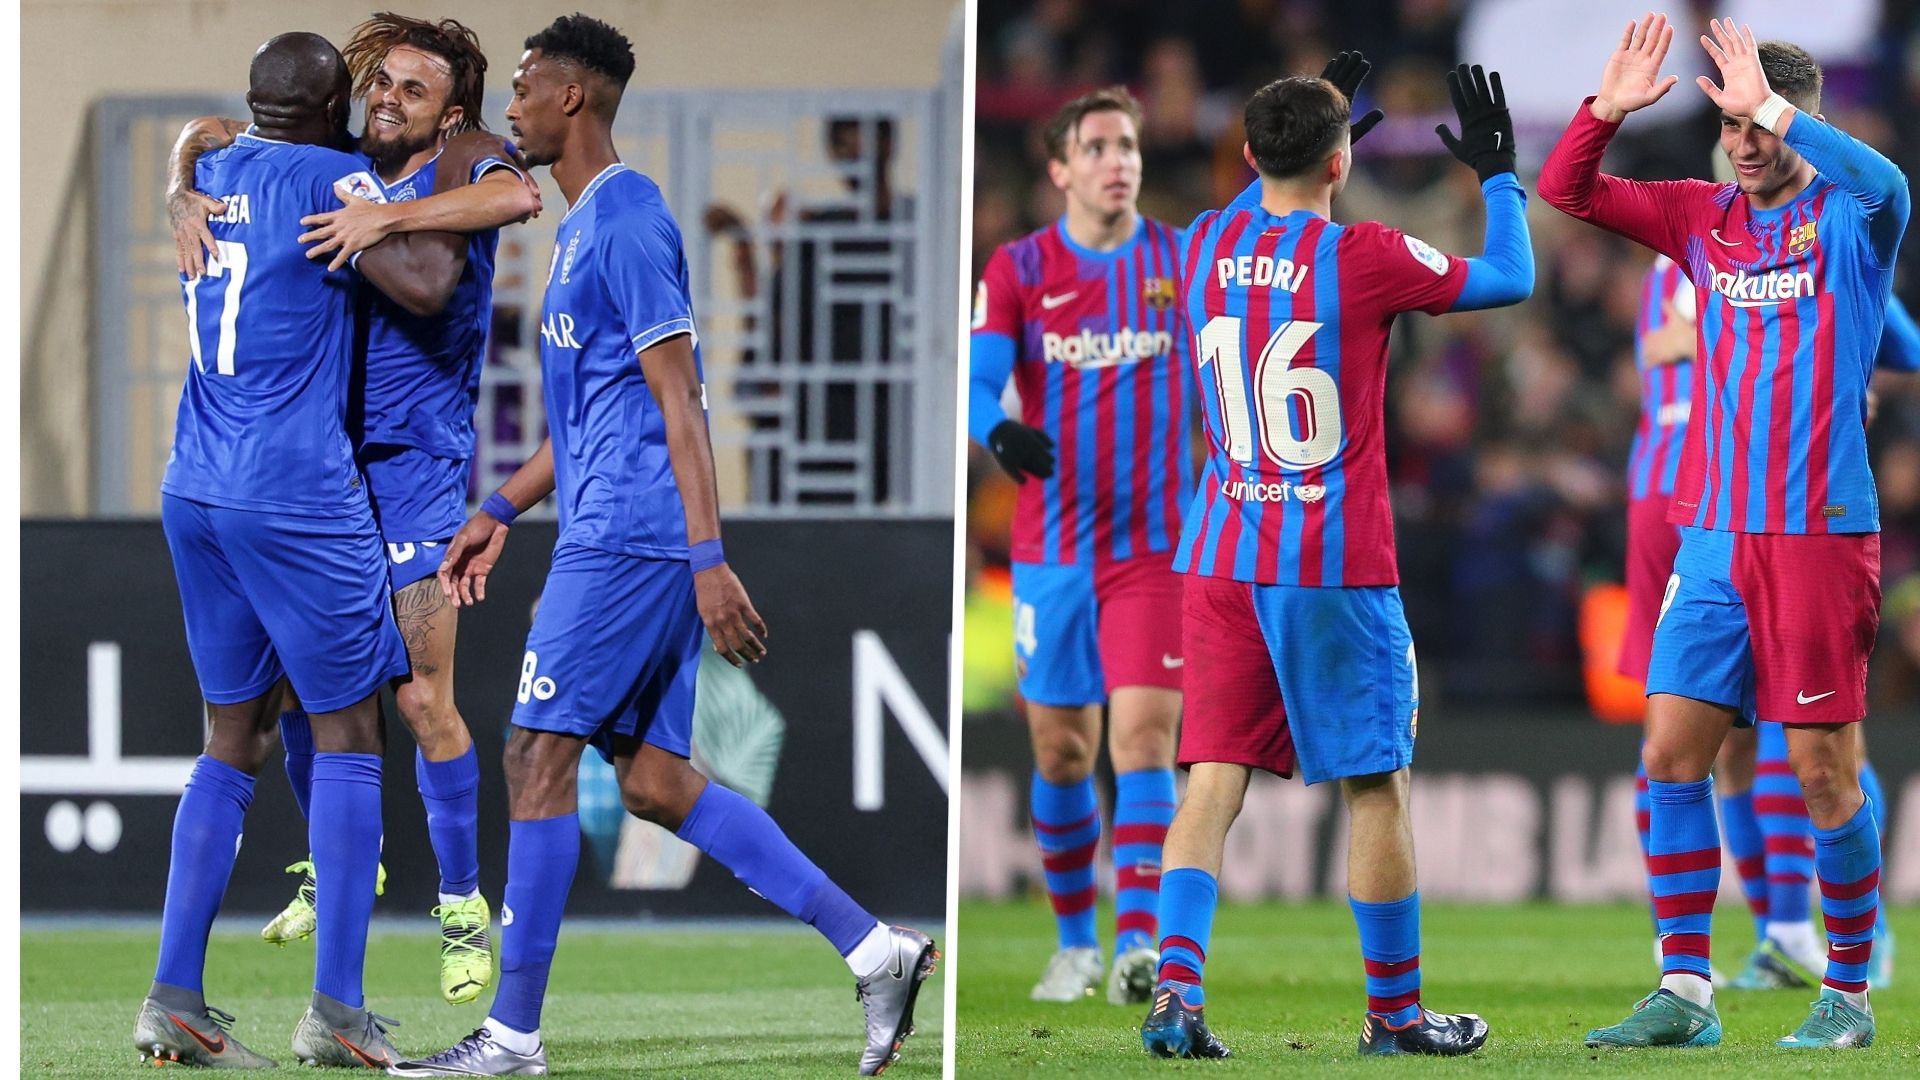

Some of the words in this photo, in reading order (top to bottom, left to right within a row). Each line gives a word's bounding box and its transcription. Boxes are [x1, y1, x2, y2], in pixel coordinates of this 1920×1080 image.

[1216, 256, 1309, 294] PEDRI
[1042, 327, 1172, 364] Rakuten
[1196, 315, 1342, 471] 16
[1221, 476, 1294, 502] unicef
